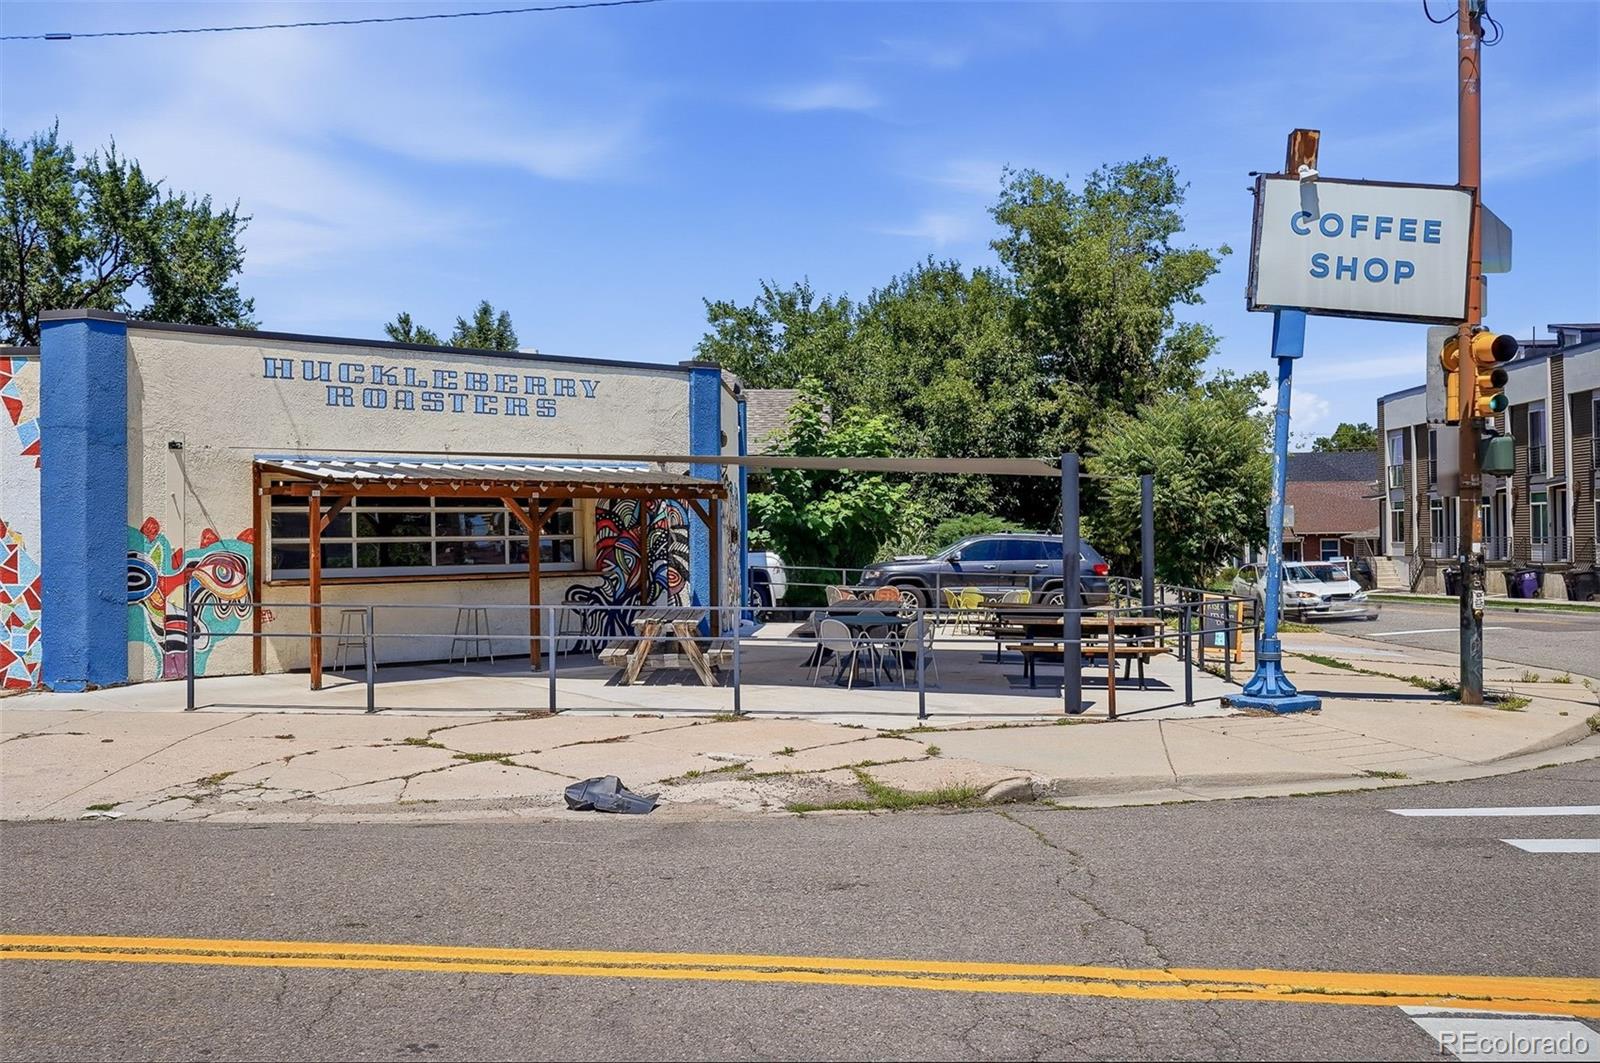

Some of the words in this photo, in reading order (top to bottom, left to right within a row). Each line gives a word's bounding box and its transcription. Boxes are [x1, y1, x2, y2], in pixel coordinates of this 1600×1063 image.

[1290, 211, 1442, 244] COFFEE
[1309, 252, 1415, 284] SHOP
[263, 356, 601, 399] HUCKLEBERRY
[325, 385, 557, 418] ROASTERS
